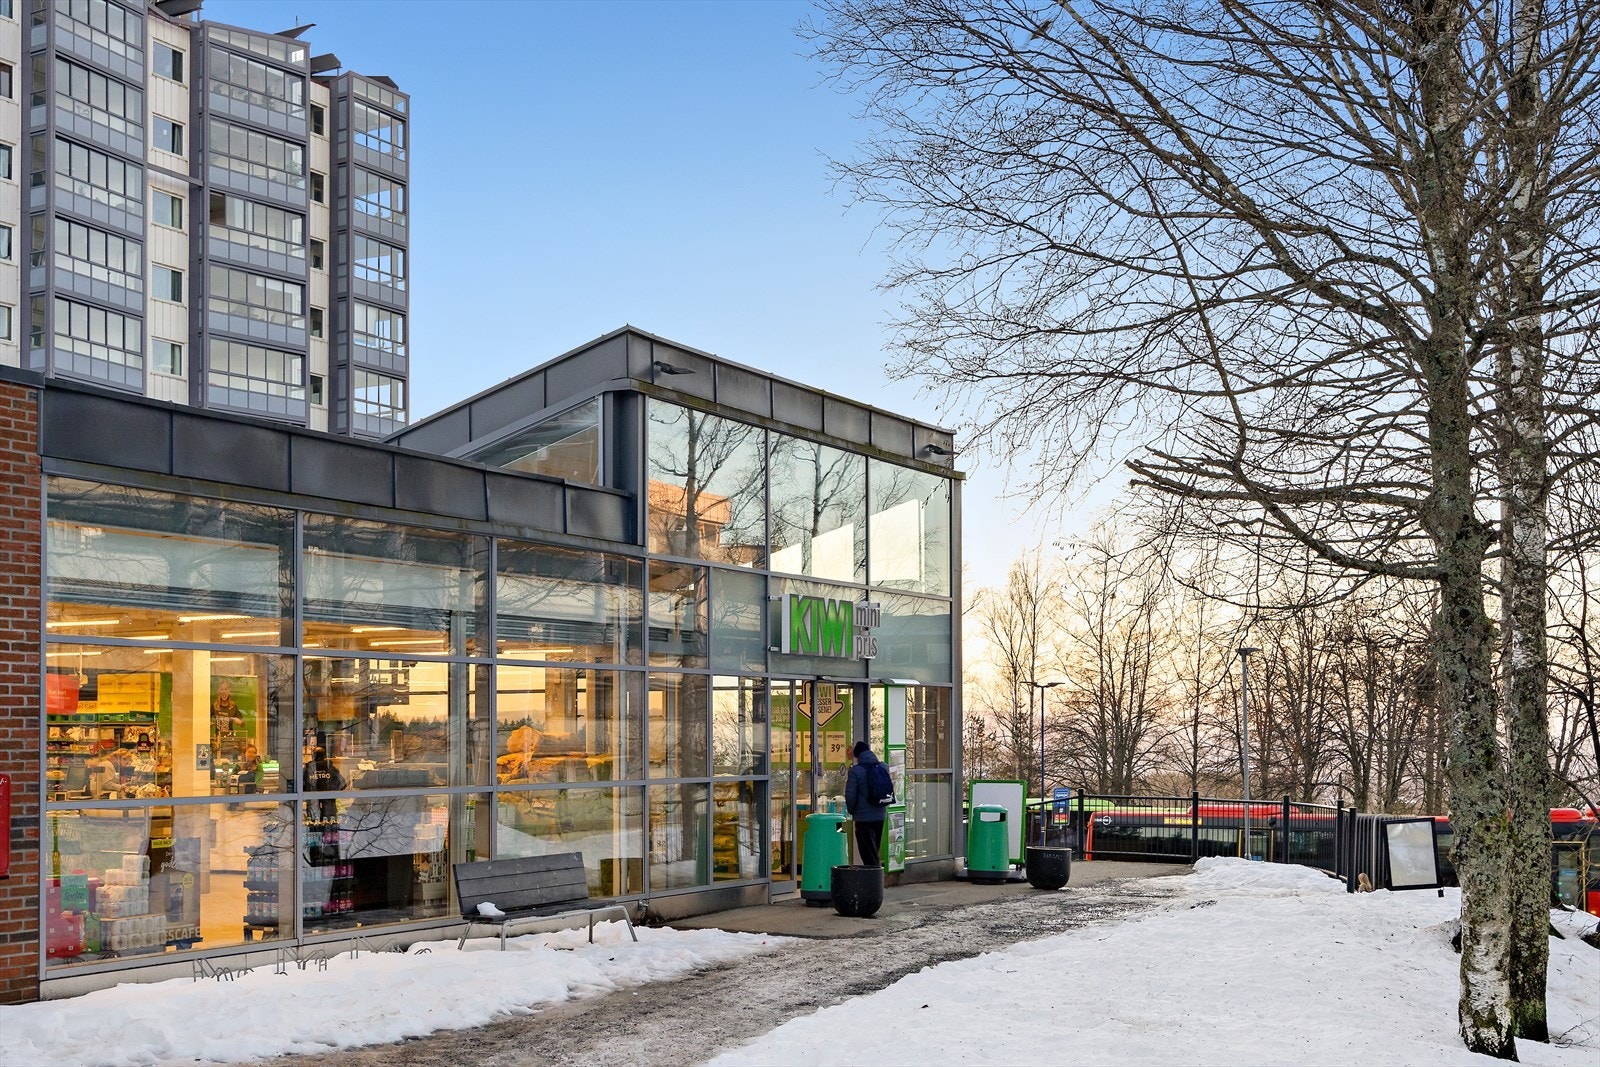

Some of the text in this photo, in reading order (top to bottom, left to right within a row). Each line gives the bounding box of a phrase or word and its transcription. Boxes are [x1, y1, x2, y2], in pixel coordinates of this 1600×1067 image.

[789, 594, 853, 658] KIWI
[856, 601, 880, 627] mini
[856, 634, 877, 660] pris
[831, 743, 841, 753] 39
[63, 890, 84, 901] Sprite
